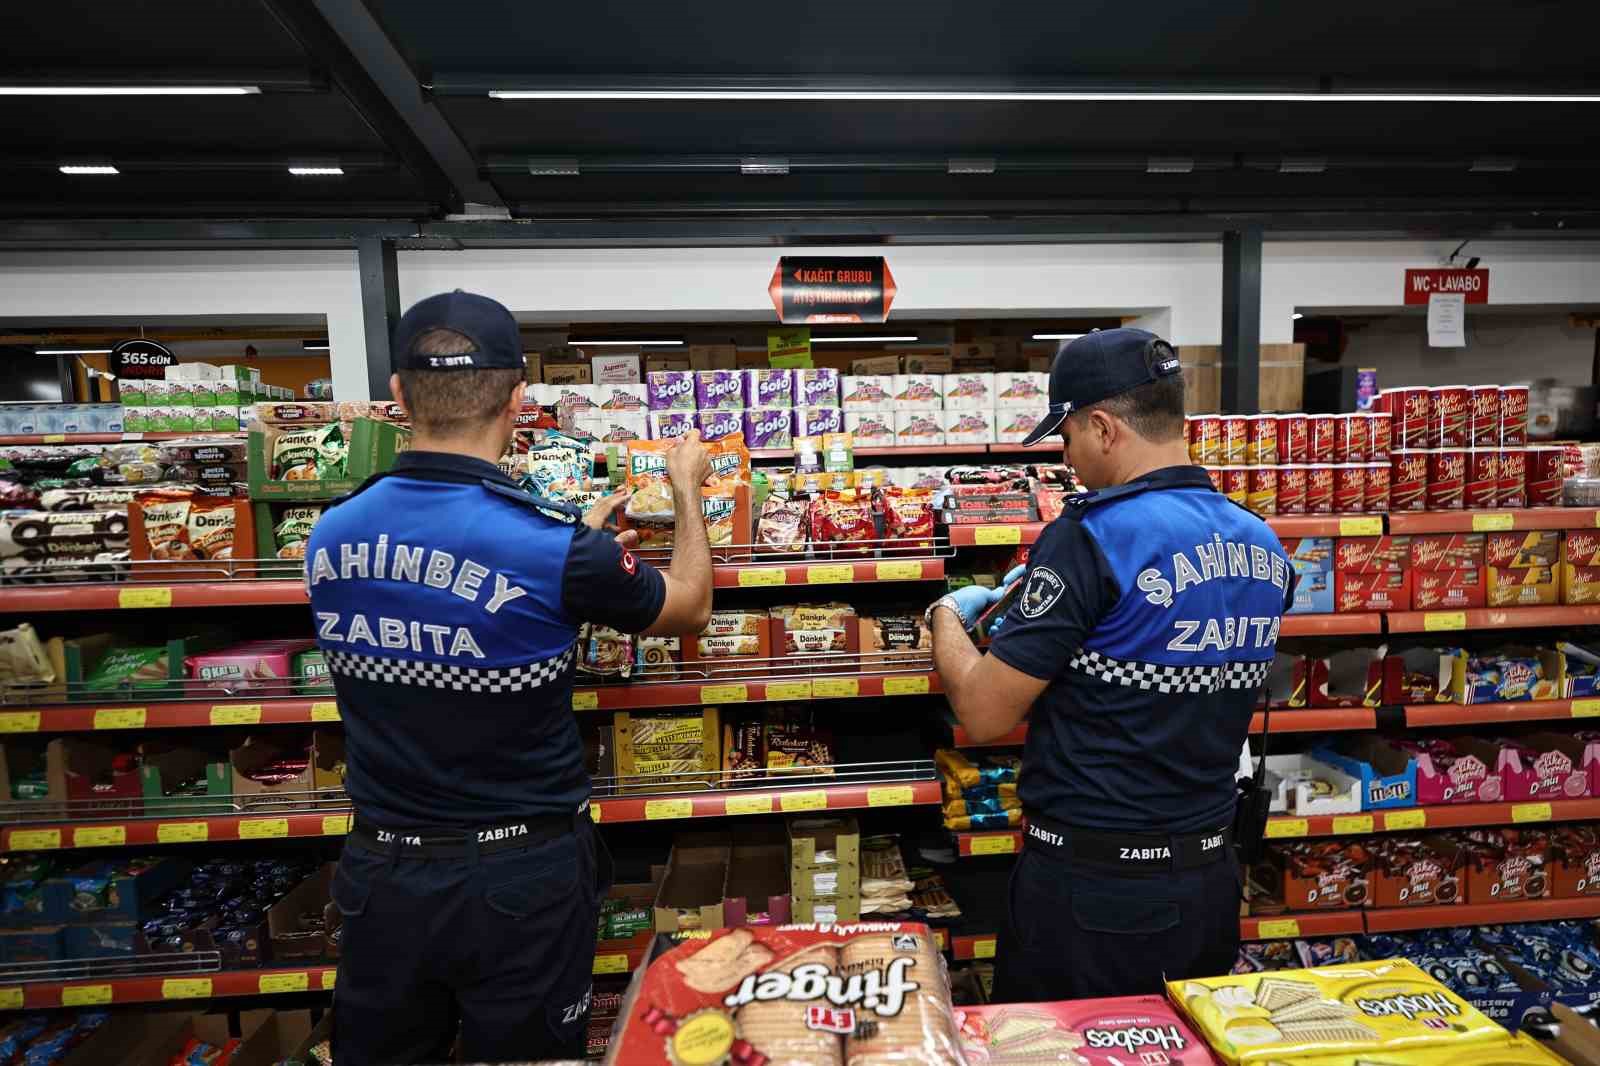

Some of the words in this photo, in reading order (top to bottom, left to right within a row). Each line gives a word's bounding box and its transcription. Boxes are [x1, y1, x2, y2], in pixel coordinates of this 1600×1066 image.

[803, 269, 833, 282] KAĞIT
[837, 270, 871, 282] GRUBU
[1413, 275, 1430, 291] WC
[1439, 275, 1480, 291] LAVABO
[121, 353, 148, 364] 365
[306, 534, 528, 613] AHİNBEY
[1137, 533, 1289, 608] ŞAHİNBE
[316, 611, 486, 659] ZABITA
[1167, 616, 1281, 652] ZABITA
[477, 824, 528, 843] ZABITA
[1030, 825, 1064, 847] ZABITA
[1119, 847, 1172, 860] ZABITA
[724, 956, 920, 1017] finger
